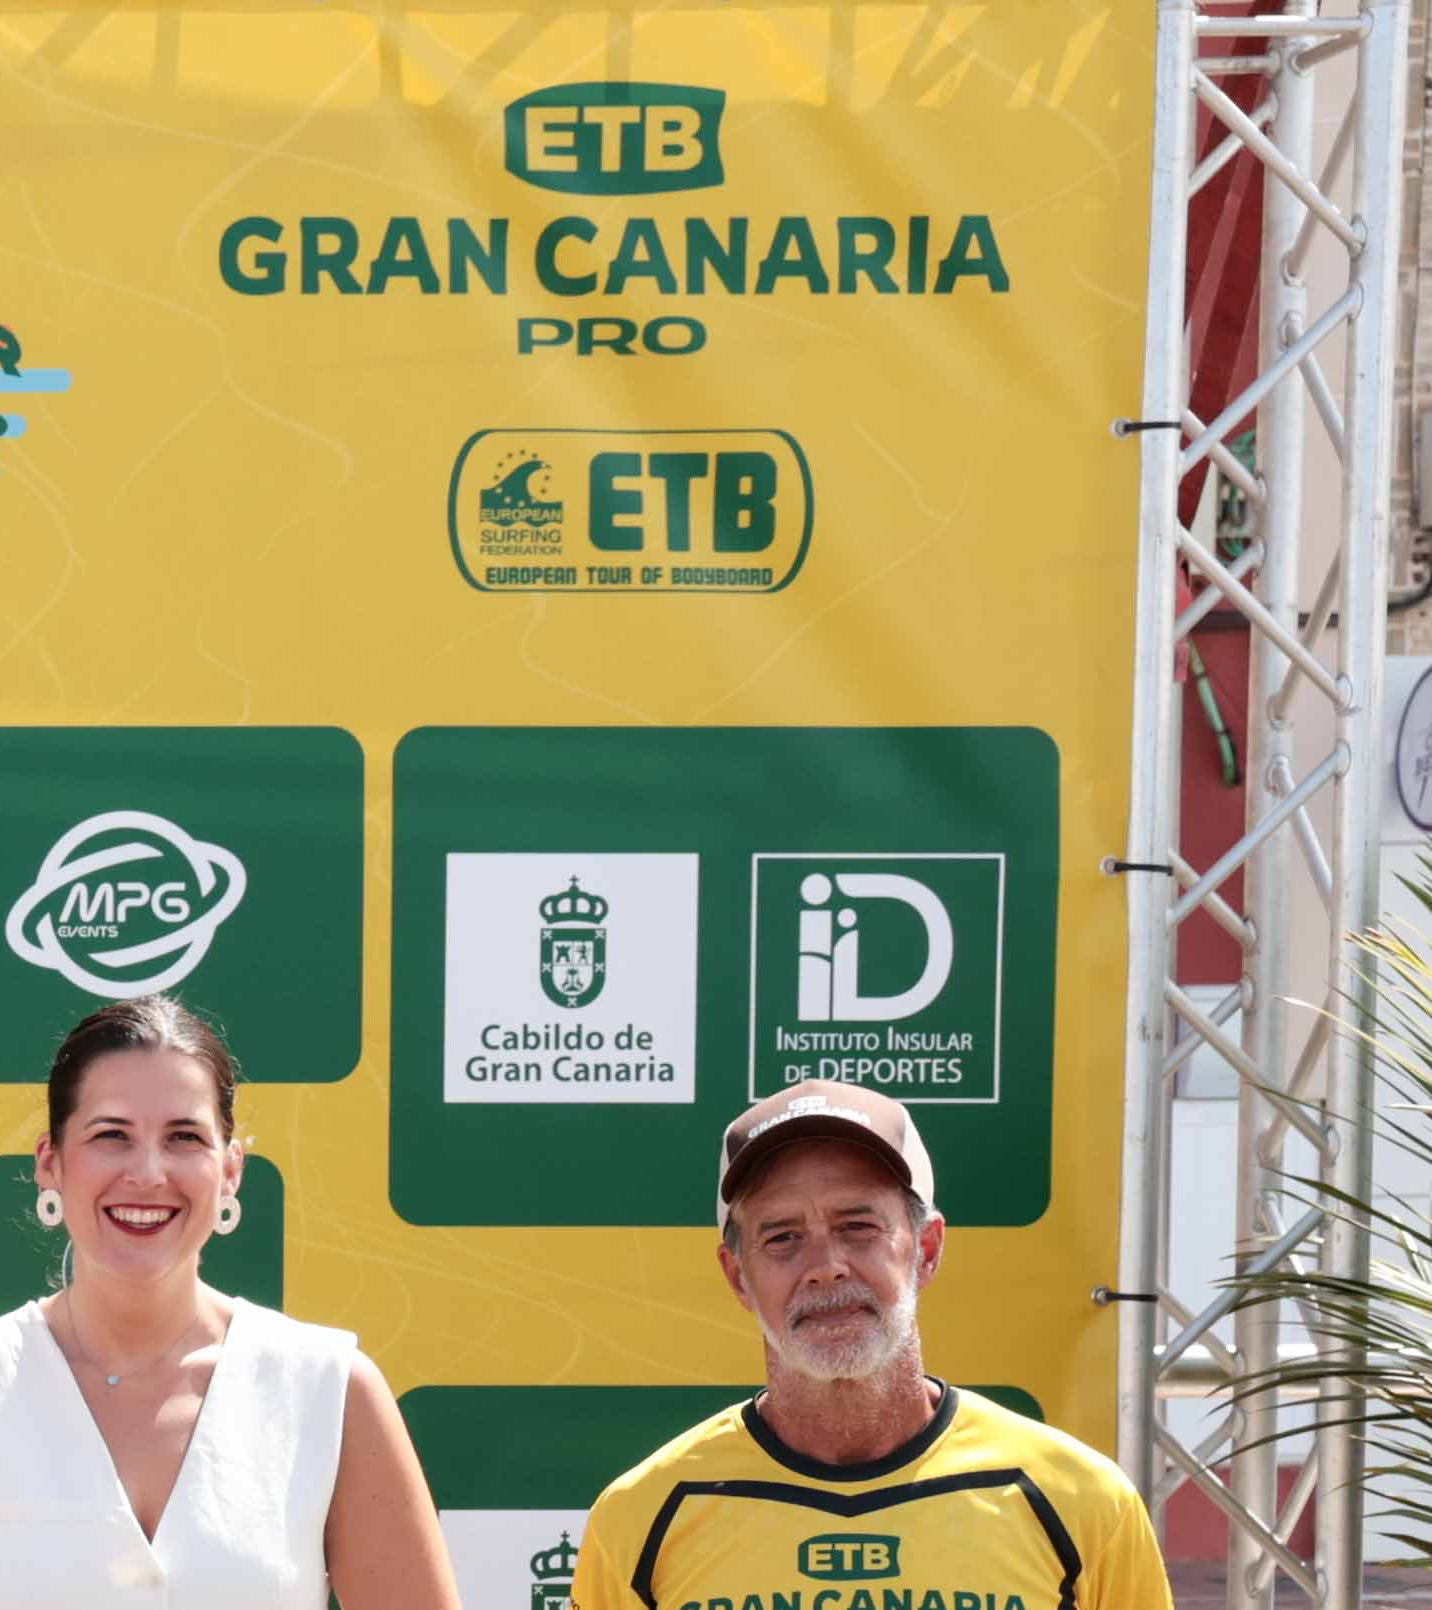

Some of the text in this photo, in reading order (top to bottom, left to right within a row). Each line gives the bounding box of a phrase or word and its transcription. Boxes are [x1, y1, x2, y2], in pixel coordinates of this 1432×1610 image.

[525, 107, 704, 173] ETB
[219, 216, 1010, 296] GRAN CANARIA
[518, 316, 706, 355] PRO
[482, 509, 561, 521] EUROPEAN
[589, 452, 777, 552] ETB
[481, 529, 561, 543] SURFING
[486, 568, 772, 585] EUROPEAN TOUR OF BODYBOARD
[59, 882, 190, 923] MPG
[58, 926, 119, 938] EVENTS
[481, 1024, 653, 1051] Cabildo de
[465, 1055, 674, 1083] Gran Canaria
[807, 1541, 891, 1573] ETB
